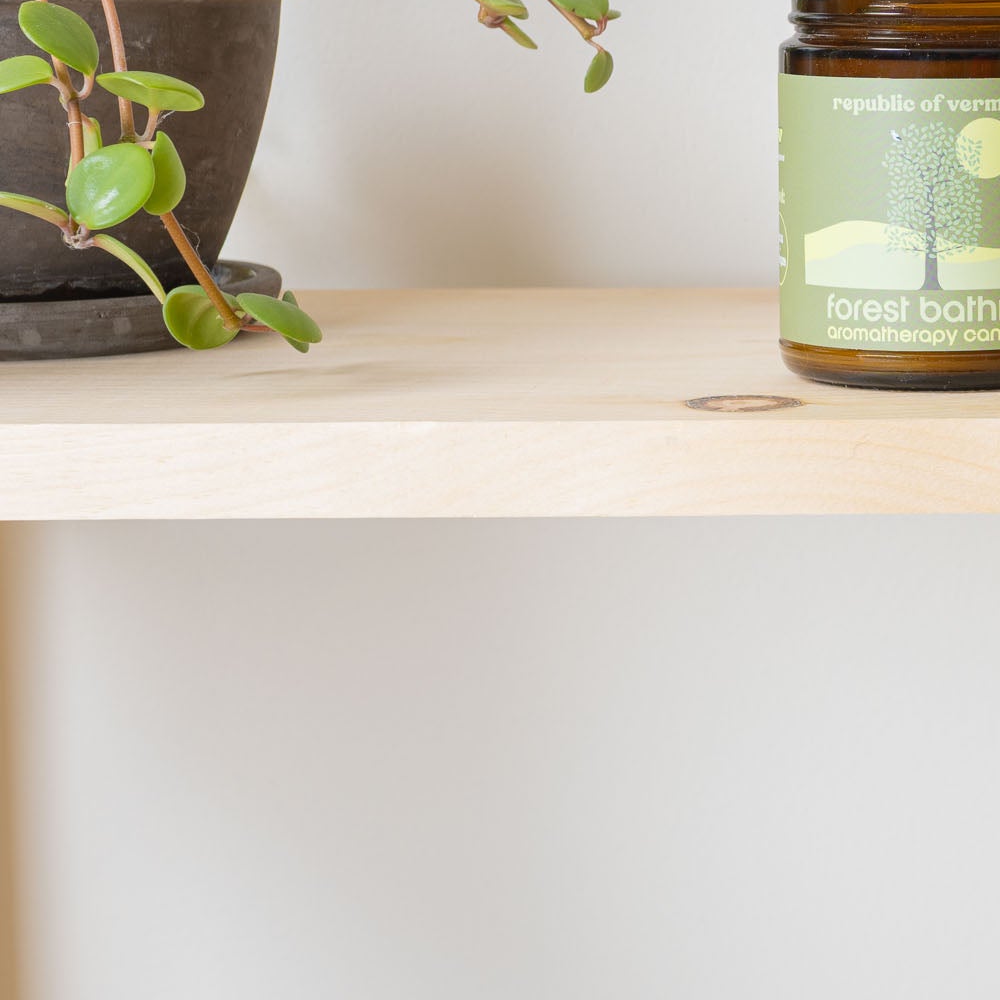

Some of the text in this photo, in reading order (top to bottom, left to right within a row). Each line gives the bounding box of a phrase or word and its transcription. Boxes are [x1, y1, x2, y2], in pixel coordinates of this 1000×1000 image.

[832, 94, 914, 115] republic
[920, 94, 945, 113] of
[827, 293, 910, 323] forest
[827, 326, 958, 346] aromatherapy
